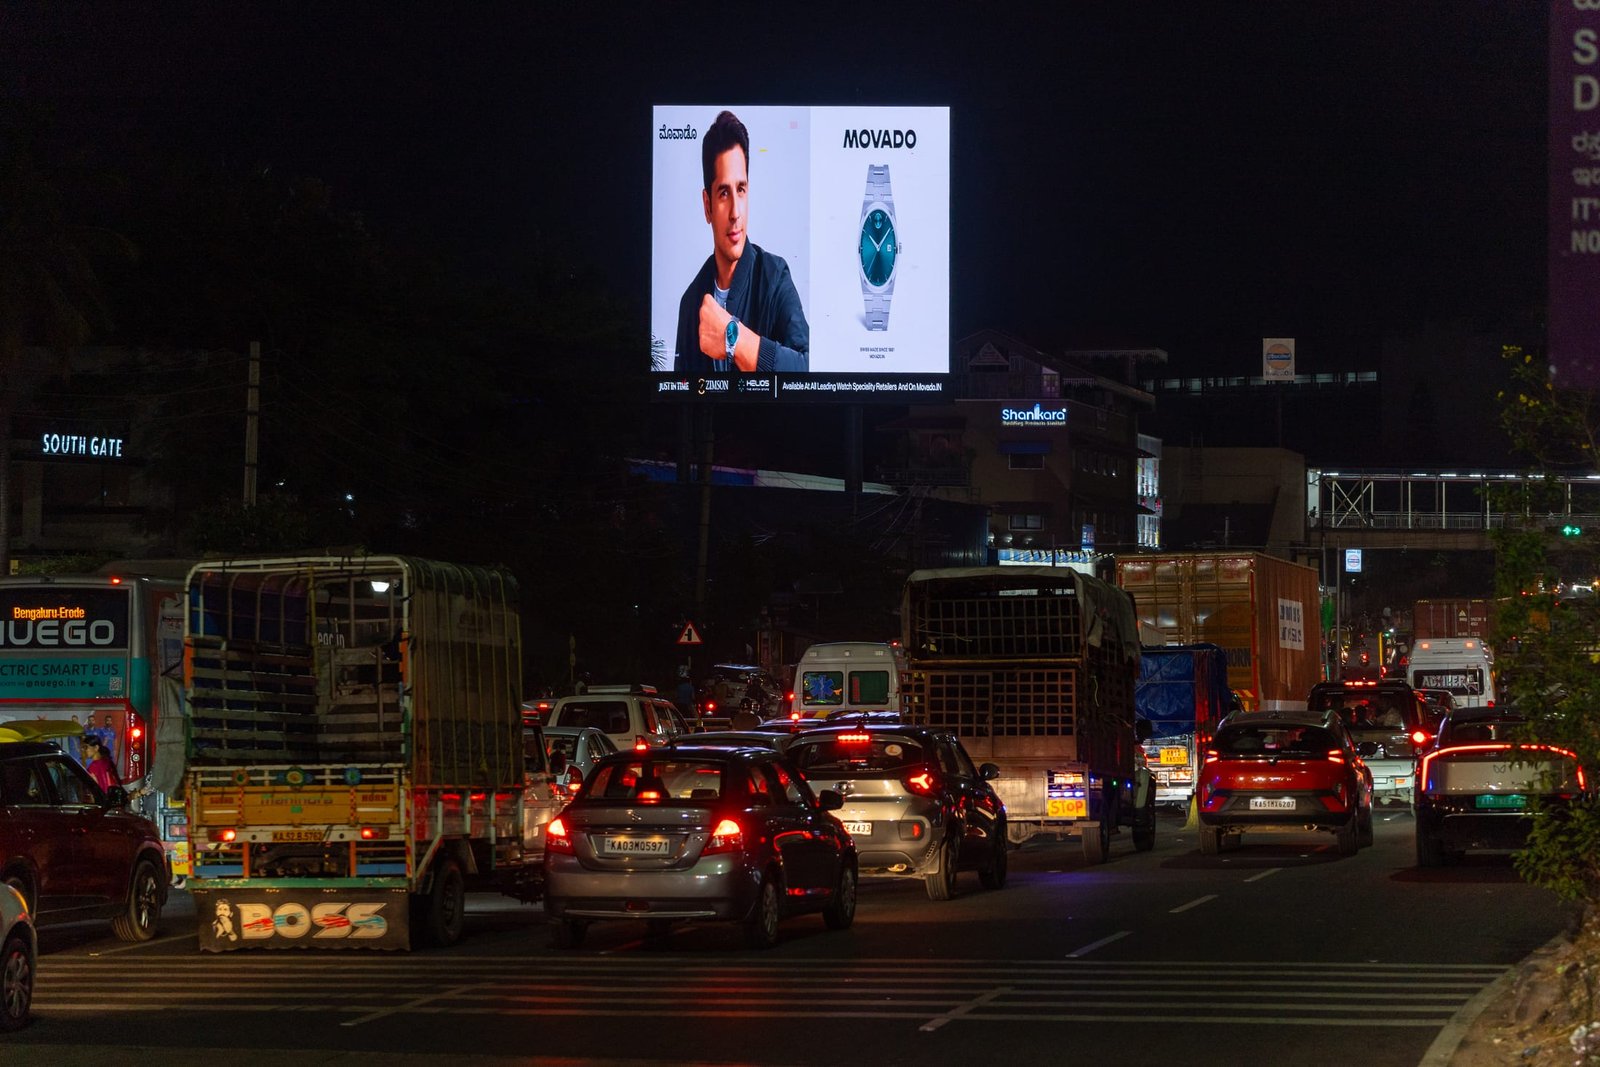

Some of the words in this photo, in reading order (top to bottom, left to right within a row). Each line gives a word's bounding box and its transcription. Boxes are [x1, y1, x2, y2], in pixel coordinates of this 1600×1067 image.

[843, 129, 917, 149] MOVADO
[658, 382, 670, 391] JUST
[705, 380, 728, 390] ZIMSON
[782, 382, 804, 390] Available
[804, 382, 810, 390] At
[817, 382, 837, 392] Leading
[837, 382, 852, 390] Watch
[876, 383, 897, 391] Retailers
[898, 383, 908, 391] And
[908, 383, 916, 391] On
[1002, 404, 1064, 420] Shankara
[43, 433, 86, 454] SOUTH
[91, 437, 122, 457] GATE
[13, 607, 85, 620] Bengaluru-Erode
[41, 664, 89, 676] SMART
[92, 664, 119, 676] BUS
[236, 902, 388, 939] BOSS
